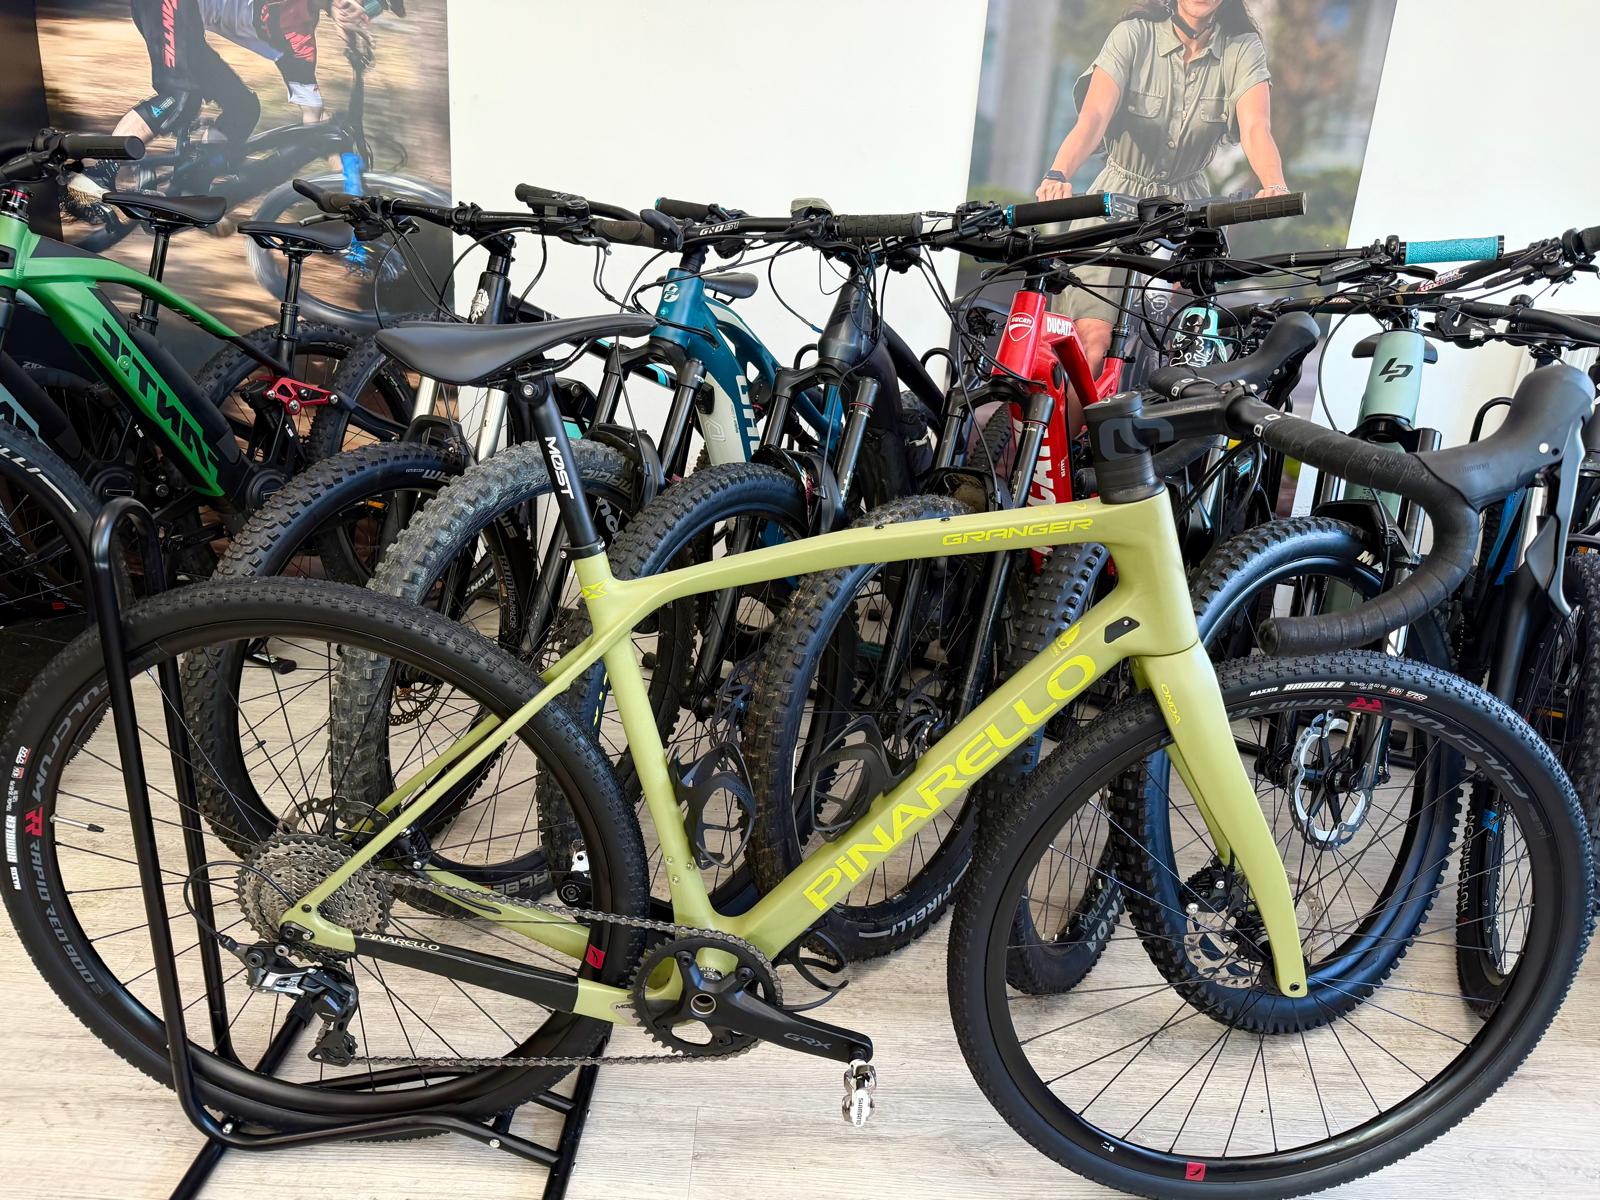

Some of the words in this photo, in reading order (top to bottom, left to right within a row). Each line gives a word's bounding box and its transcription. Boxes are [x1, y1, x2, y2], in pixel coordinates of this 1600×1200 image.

[1046, 316, 1072, 337] DUCATI
[544, 436, 576, 500] MOST
[942, 518, 1094, 546] GRANGER
[1160, 683, 1181, 725] ONDA
[1250, 686, 1280, 697] MAXXIS
[1282, 681, 1346, 691] RAMBLER
[803, 653, 1097, 911] PINARELLO
[5, 815, 18, 863] RAMBLER
[1460, 815, 1476, 912] HUTCHINSON
[890, 882, 953, 937] PIRELLI
[360, 932, 441, 951] PINARELLO
[783, 1032, 833, 1050] GRX
